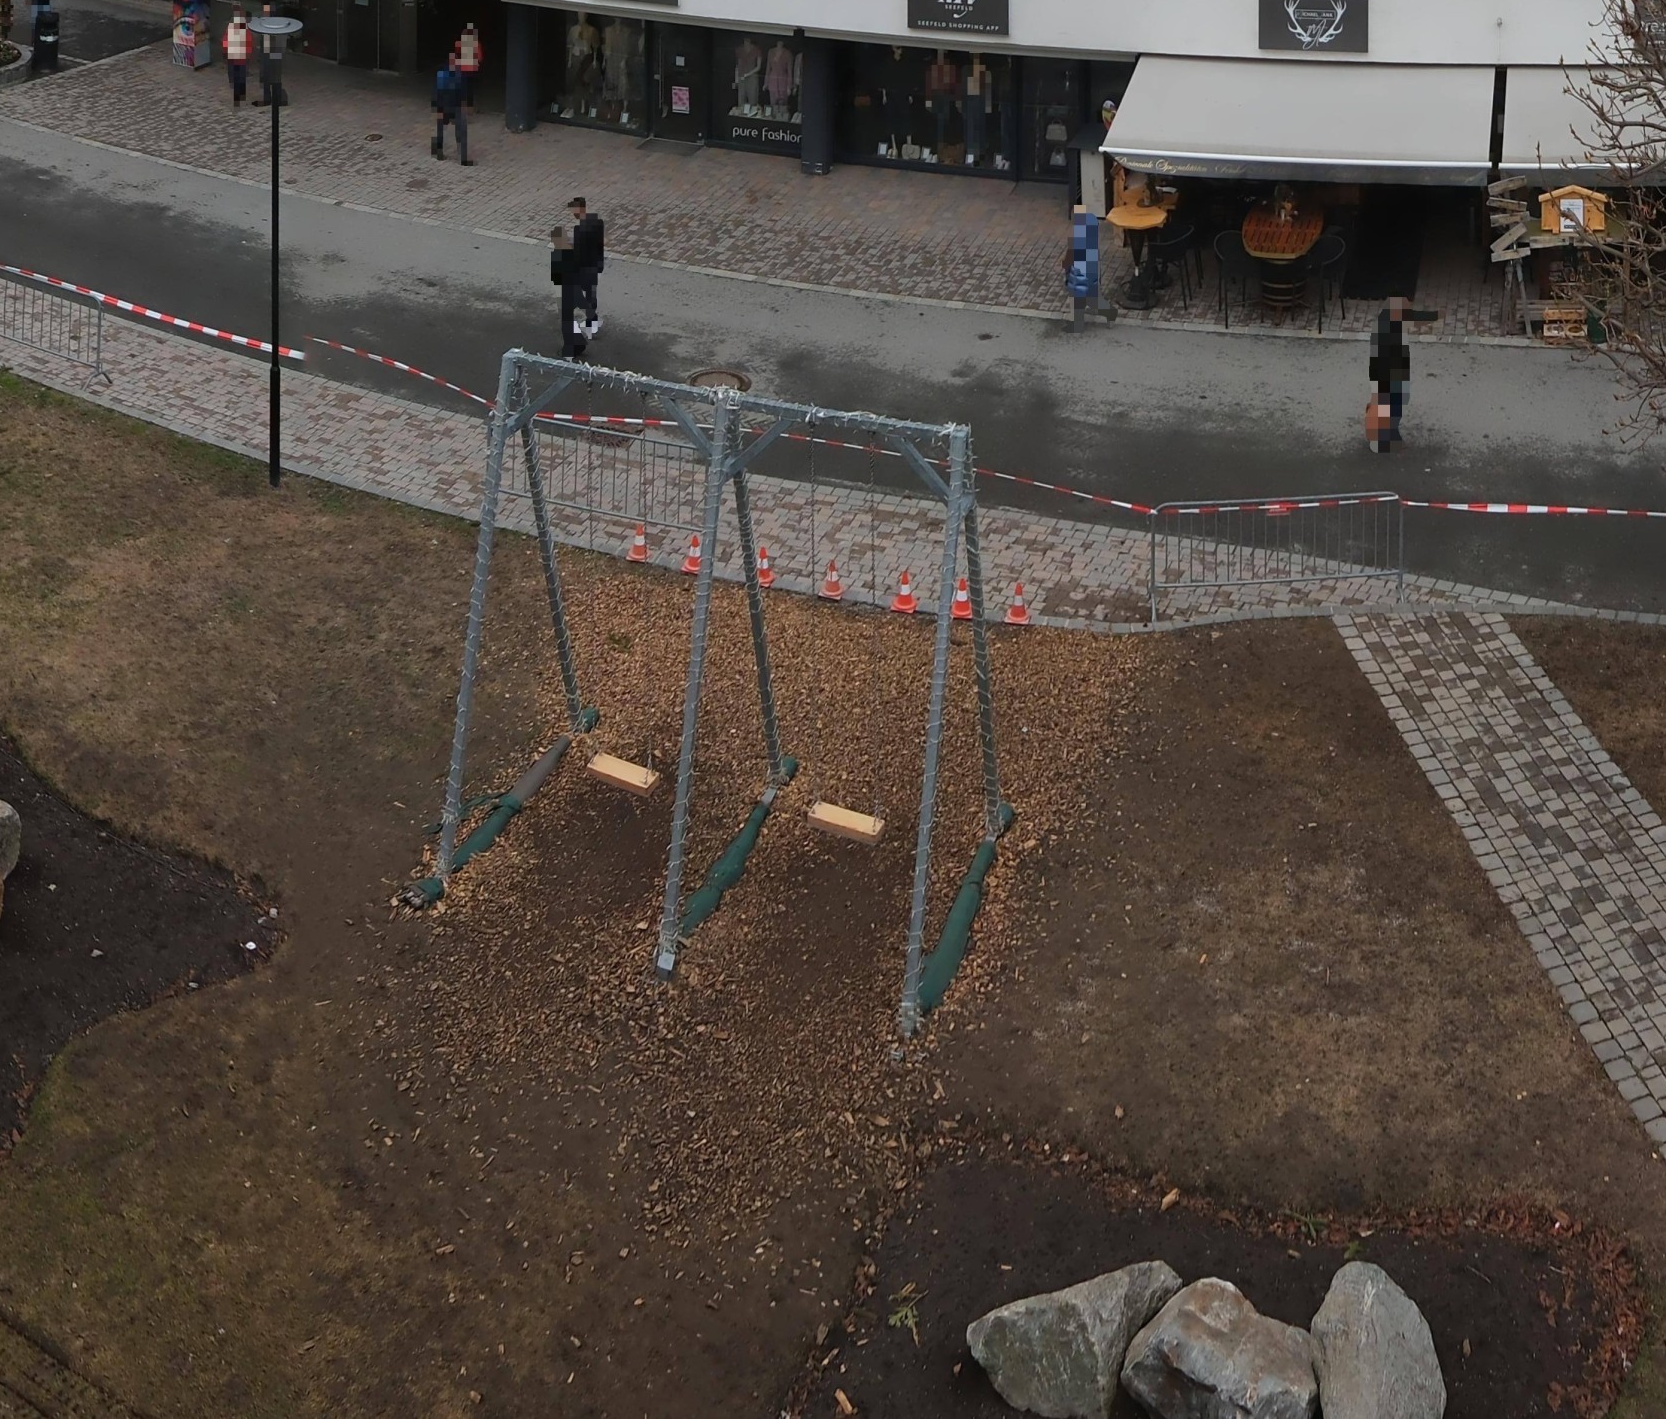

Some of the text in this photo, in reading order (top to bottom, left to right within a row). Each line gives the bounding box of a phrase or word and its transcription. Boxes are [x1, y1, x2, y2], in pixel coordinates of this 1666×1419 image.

[917, 20, 947, 28] SEEFELD
[948, 22, 984, 30] SHOPPING
[732, 126, 759, 138] pure
